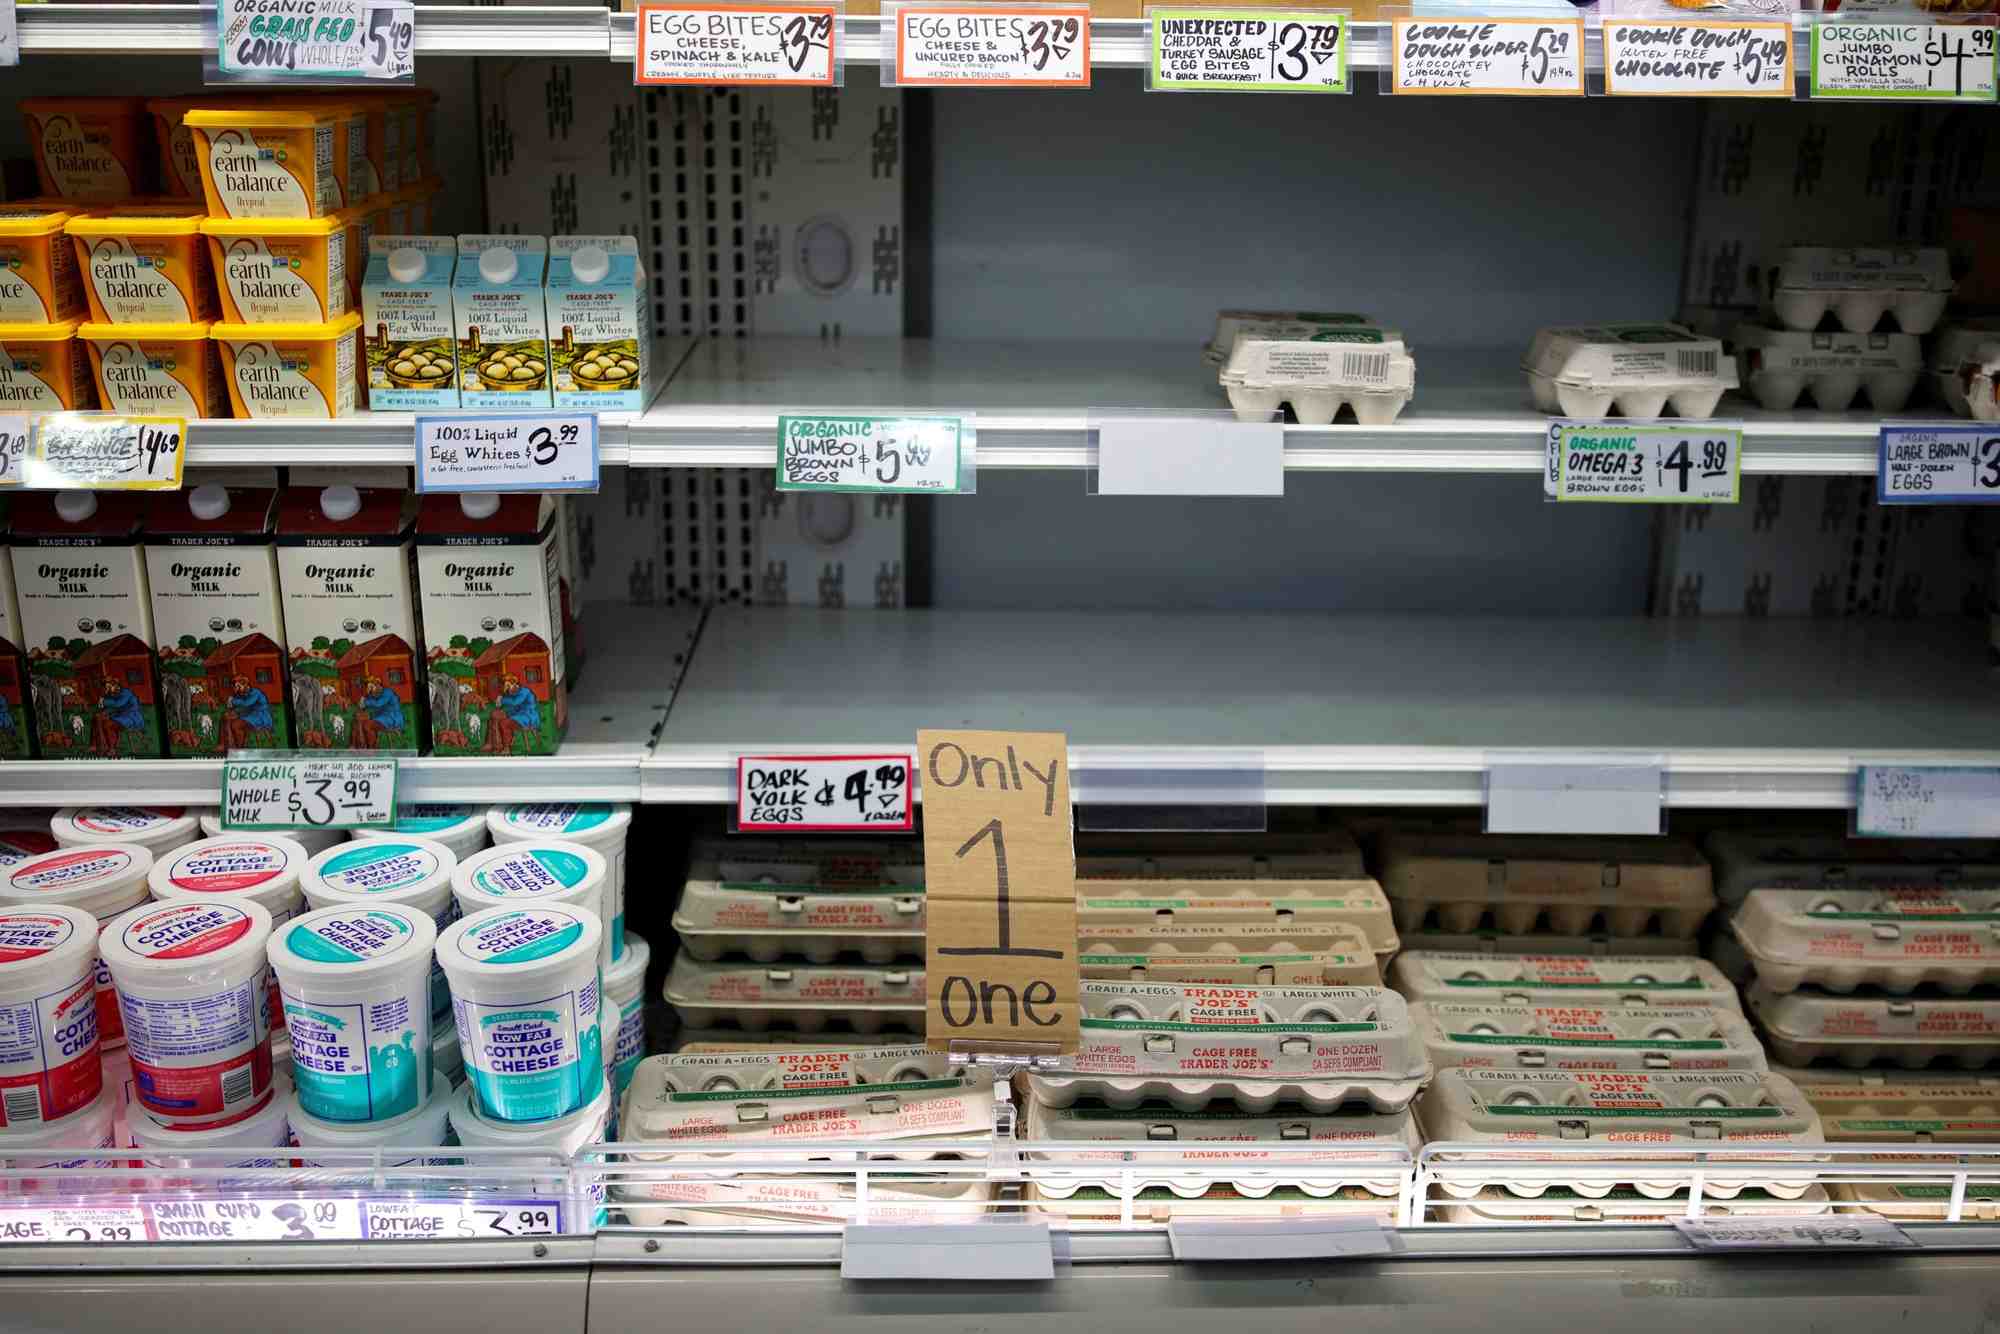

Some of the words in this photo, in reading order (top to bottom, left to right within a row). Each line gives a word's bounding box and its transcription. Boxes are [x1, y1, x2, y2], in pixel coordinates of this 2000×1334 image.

[234, 0, 316, 13] ORGANIC
[318, 1, 356, 14] MILK
[249, 15, 315, 41] GRASS
[315, 16, 356, 42] FED
[650, 15, 700, 34] EGG
[708, 15, 783, 36] BITES
[907, 18, 950, 38] EGG
[957, 18, 1023, 38] BITES
[1161, 20, 1267, 36] UNEXPECTED
[1406, 24, 1496, 41] COOKIE
[1163, 35, 1222, 47] CHEDDAR
[1229, 39, 1241, 47] &
[1616, 27, 1687, 45] COOKIE
[1691, 28, 1752, 48] DOUGH
[1822, 27, 1917, 42] ORGANIC
[237, 39, 297, 69] COWS
[925, 41, 980, 51] CHEESE
[986, 42, 997, 50] &
[1160, 49, 1204, 60] TURKEY
[1209, 48, 1265, 60] SAUSAGE
[1404, 43, 1465, 59] DOUGH
[1469, 41, 1528, 58] SUPER
[1620, 47, 1666, 57] GLUTEN
[1674, 49, 1709, 59] FREE
[1840, 43, 1893, 54] JUMBO
[650, 50, 719, 61] SPINACH
[726, 51, 737, 61] &
[742, 51, 780, 63] KALE
[915, 53, 974, 62] UNCURED
[978, 53, 1019, 63] BACON
[1824, 54, 1921, 66] CINNAMON
[1171, 60, 1197, 70] EGG
[1205, 60, 1250, 70] BITES
[1407, 61, 1491, 71] CHOCOLATEY
[1615, 60, 1725, 80] CHOCOLATE
[1847, 66, 1898, 77] ROLLS
[1176, 72, 1198, 81] QUICK
[1203, 72, 1261, 82] BREAKFAST!
[1409, 70, 1472, 78] CHOCOLATE
[1403, 79, 1470, 87] CHUNK
[216, 155, 257, 172] earth
[226, 174, 288, 193] balance
[95, 262, 136, 279] earth
[230, 262, 271, 279] earth
[106, 281, 167, 298] balance
[240, 280, 301, 298] balance
[107, 364, 146, 382] earth
[239, 365, 280, 382] earth
[117, 383, 177, 400] balance
[250, 383, 309, 401] balance
[435, 427, 471, 441] 100%
[475, 427, 518, 445] Liquid
[788, 421, 873, 437] ORGANIC
[786, 438, 857, 456] JUMBO
[1569, 436, 1637, 451] ORGANIC
[1888, 444, 1924, 461] LARGE
[1928, 442, 1970, 460] BROWN
[430, 446, 458, 464] Egg
[465, 447, 520, 460] Whites
[785, 457, 854, 470] BROWN
[1568, 453, 1628, 474] OMEGA
[1631, 454, 1644, 475] 3
[789, 470, 839, 482] EGGS
[1892, 474, 1933, 490] EGGS
[1567, 484, 1609, 493] BROWN
[1614, 484, 1645, 493] EGGS
[38, 563, 109, 581] Organic
[170, 562, 241, 581] Organic
[305, 564, 376, 582] Organic
[445, 563, 515, 581] Organic
[58, 583, 88, 593] MILK
[191, 582, 221, 592] MILK
[325, 583, 354, 593] MILK
[464, 582, 493, 592] MILK
[229, 766, 296, 780] ORGANIC
[747, 769, 810, 790] DARK
[929, 742, 1057, 816] Only
[229, 789, 281, 806] WHOLE
[750, 790, 808, 806] YOLK
[229, 808, 262, 823] MILK
[750, 807, 803, 823] EGGS
[186, 856, 273, 868] COTTAGE
[190, 864, 266, 875] CHEESE
[938, 818, 1063, 958] 1
[137, 911, 224, 946] COTTAGE
[153, 918, 228, 950] CHEESE
[328, 920, 385, 950] COTTAGE
[477, 919, 554, 951] COTTAGE
[318, 927, 368, 953] CHEESE
[492, 926, 559, 953] CHEESE
[1183, 989, 1259, 998] TRADER
[1282, 991, 1317, 999] LARGE
[1320, 990, 1356, 999] WHITE
[1195, 998, 1249, 1008] JOE'S
[1190, 1008, 1221, 1016] CAGE
[1224, 1008, 1257, 1016] FREE
[1535, 1009, 1605, 1017] TRADER
[1550, 1017, 1598, 1025] JOE'S
[494, 1033, 520, 1042] LOW
[525, 1030, 550, 1040] FAT
[484, 1037, 564, 1058] COTTAGE
[1089, 1045, 1121, 1054] LARGE
[1192, 1047, 1224, 1057] CAGE
[1227, 1047, 1258, 1057] FREE
[1317, 1046, 1340, 1056] ONE
[1342, 1044, 1378, 1054] DOZEN
[490, 1056, 560, 1073] CHEESE
[681, 1056, 721, 1065] GRADE
[777, 1054, 850, 1064] TRADER
[872, 1048, 909, 1058] LARGE
[1180, 1059, 1229, 1069] TRADER
[787, 1062, 841, 1072] JOE'S
[782, 1072, 815, 1081] CAGE
[816, 1071, 849, 1080] FREE
[1480, 1072, 1519, 1081] GRADE
[1575, 1074, 1649, 1083] TRADER
[1672, 1075, 1710, 1083] LARGE
[1711, 1074, 1745, 1084] WHITE
[1592, 1083, 1643, 1092] JOE'S
[1589, 1092, 1623, 1100] CAGE
[1625, 1092, 1657, 1101] FREE
[682, 1118, 714, 1126] LARGE
[783, 1111, 816, 1122] CAGE
[818, 1110, 848, 1120] FREE
[902, 1102, 924, 1113] ONE
[927, 1099, 962, 1111] DOZEN
[668, 1126, 700, 1135] WHITE
[772, 1123, 819, 1134] TRADER
[1608, 1132, 1641, 1142] CAGE
[1642, 1131, 1672, 1142] FREE
[1729, 1132, 1754, 1140] ONE
[1755, 1131, 1791, 1140] DOZEN
[159, 1221, 234, 1236] COTTAGE
[370, 1216, 444, 1231] COTTAGE
